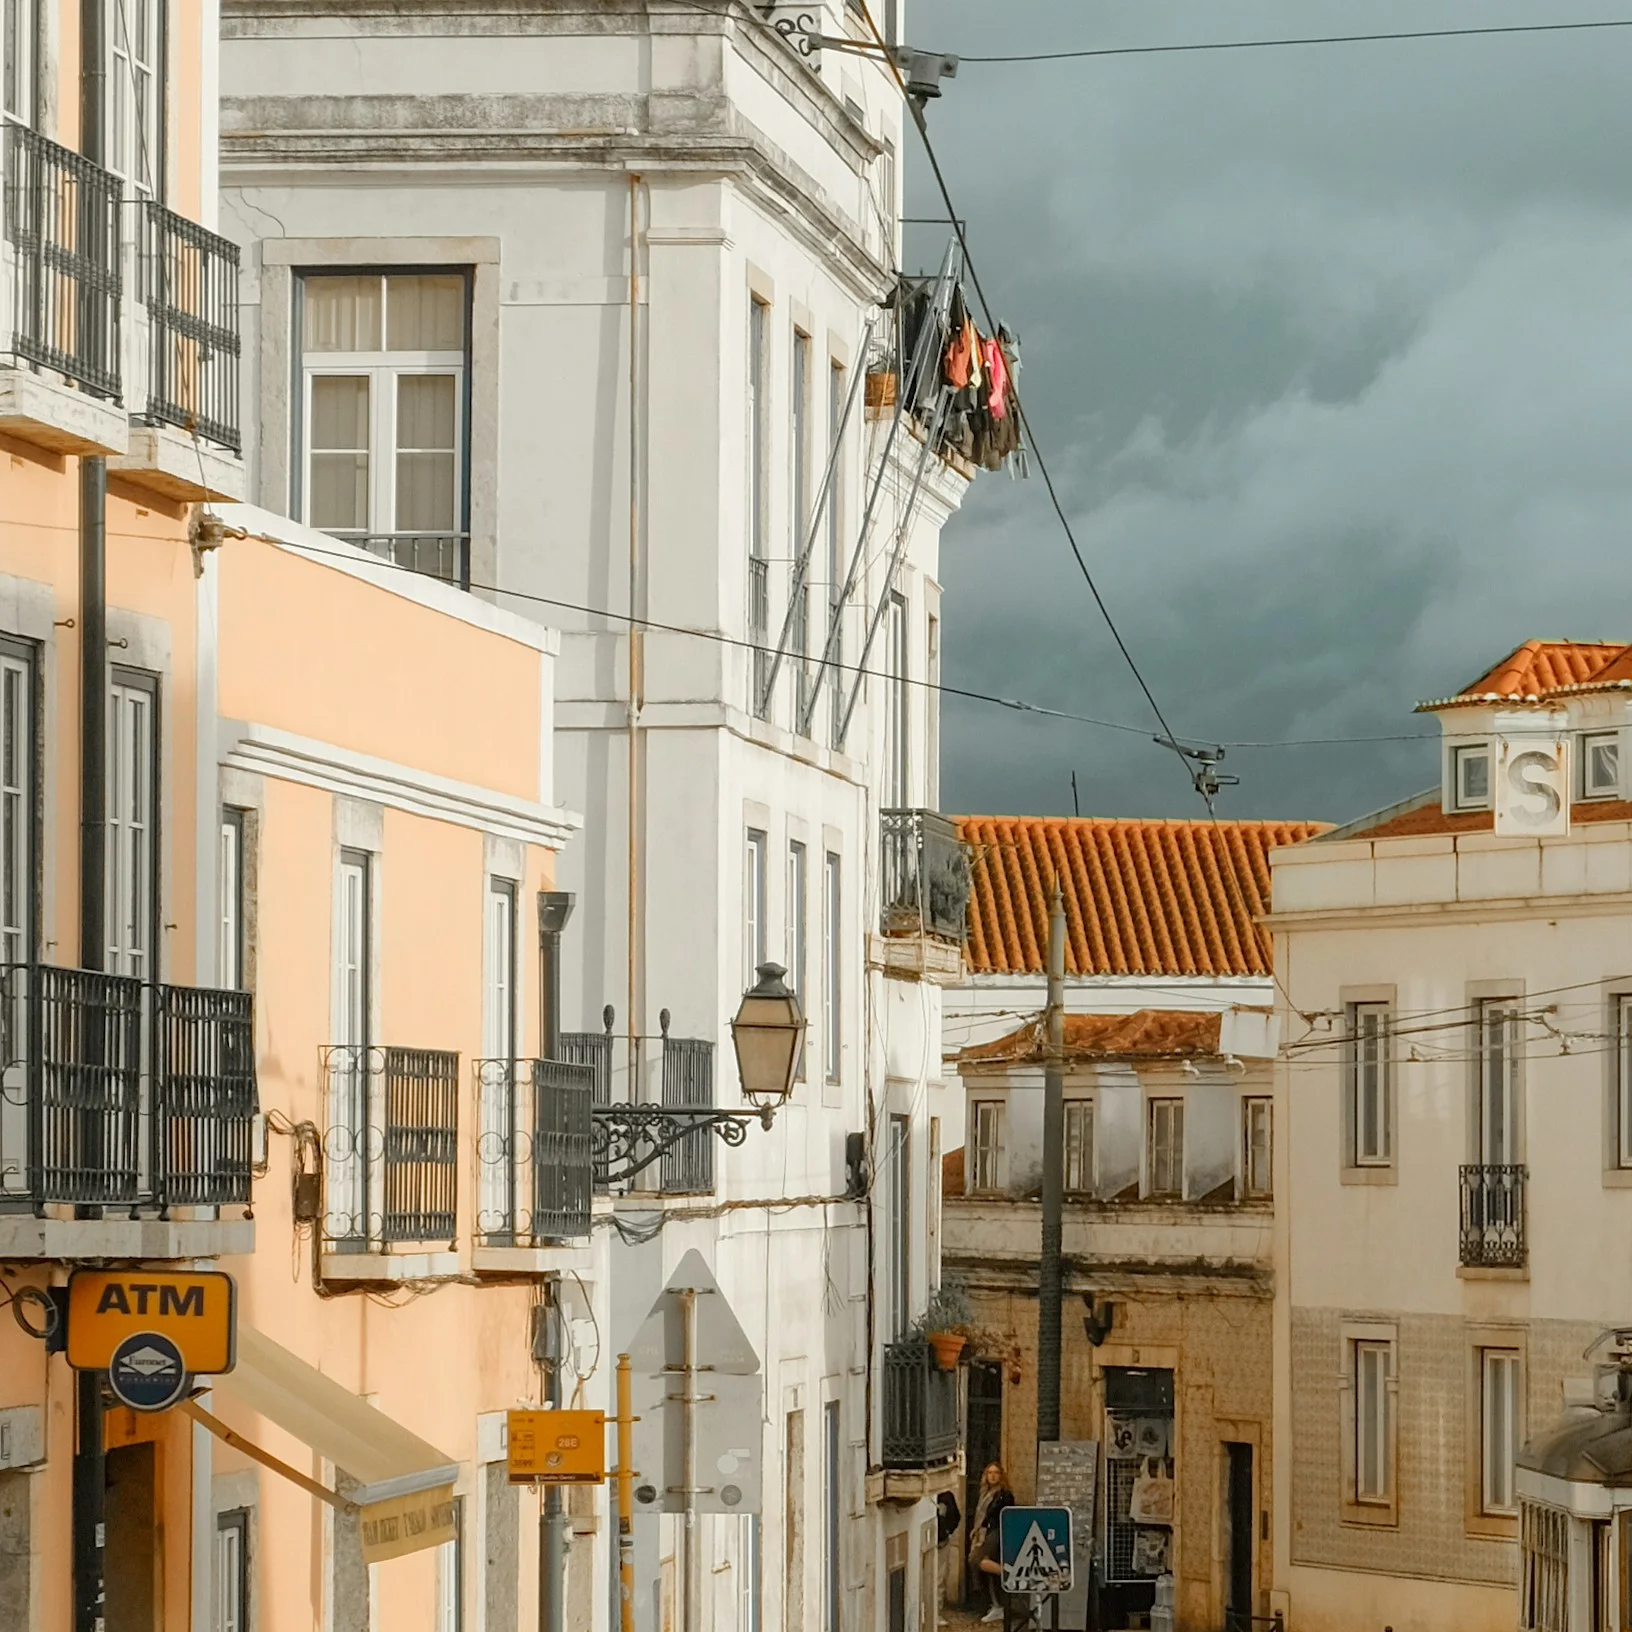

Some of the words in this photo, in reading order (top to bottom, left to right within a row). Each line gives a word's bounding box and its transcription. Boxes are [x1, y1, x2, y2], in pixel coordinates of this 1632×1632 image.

[1507, 750, 1561, 827] S
[96, 1283, 204, 1316] ATM
[129, 1356, 167, 1366] Euronet
